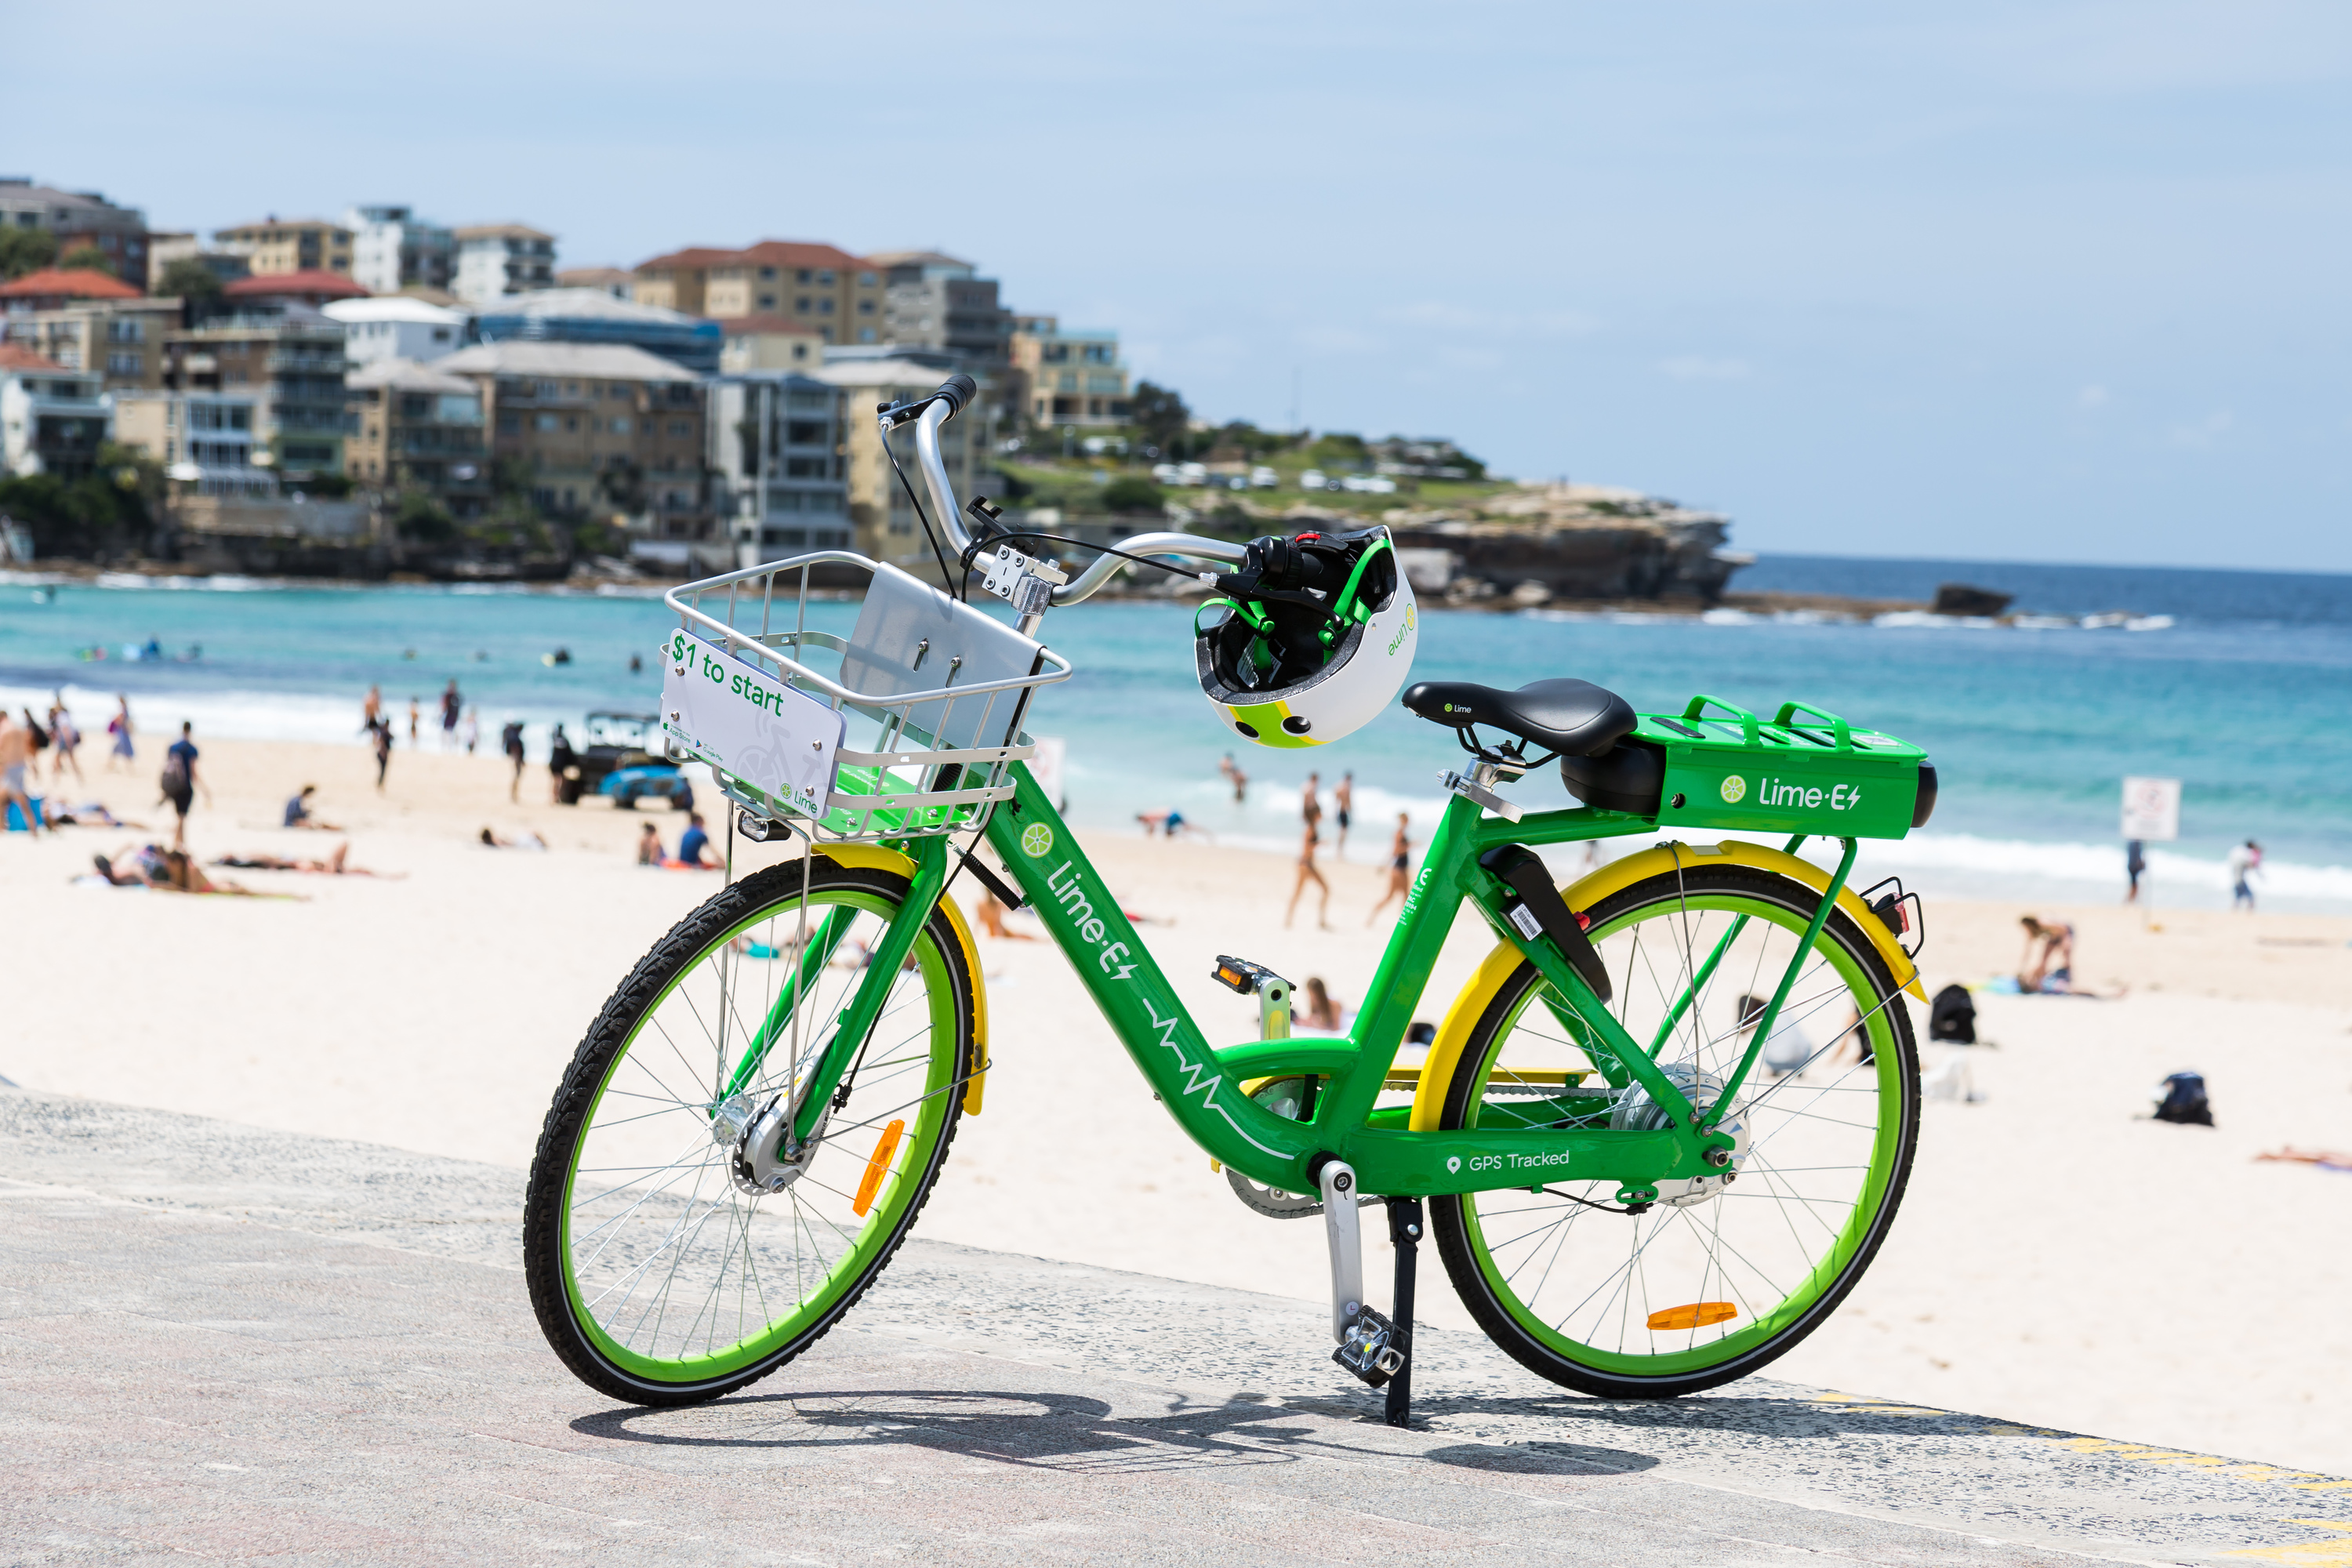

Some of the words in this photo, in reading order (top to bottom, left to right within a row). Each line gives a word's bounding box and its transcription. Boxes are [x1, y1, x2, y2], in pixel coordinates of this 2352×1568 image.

[1388, 623, 1407, 655] Lime
[672, 633, 696, 668] $1
[703, 654, 724, 683] to
[731, 674, 784, 717] start
[1454, 705, 1472, 713] Lime
[669, 728, 679, 737] App
[679, 732, 691, 743] Store
[795, 790, 818, 814] Lime
[1469, 1155, 1502, 1171] GPS
[1507, 1149, 1569, 1168] Tracked
